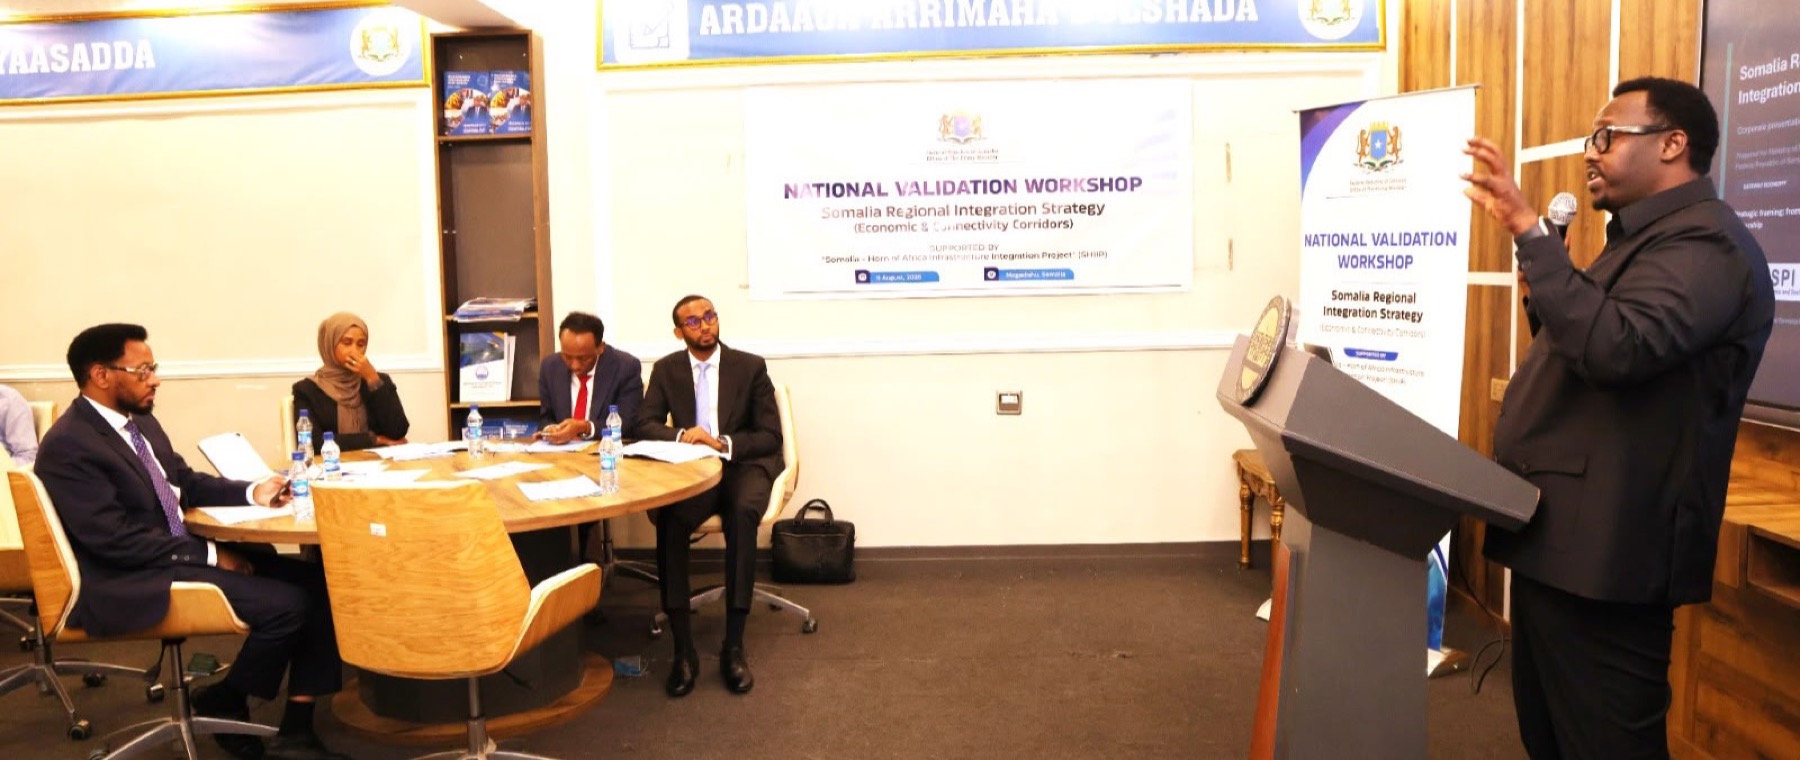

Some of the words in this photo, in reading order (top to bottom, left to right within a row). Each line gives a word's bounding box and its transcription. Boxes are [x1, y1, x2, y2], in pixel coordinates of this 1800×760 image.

[1740, 57, 1788, 80] Somalia
[1790, 53, 1800, 69] R
[1739, 80, 1800, 105] Integration
[784, 181, 888, 199] NATIONAL
[895, 179, 1017, 198] VALIDATION
[1024, 176, 1143, 194] WORKSHOP
[821, 205, 882, 219] Somalia
[886, 204, 950, 219] Regional
[954, 203, 1037, 217] Integration
[1042, 202, 1106, 216] Strategy
[854, 221, 917, 234] (Economic
[1013, 218, 1074, 230] Corridors)
[1304, 233, 1367, 247] NATIONAL
[1371, 231, 1458, 247] VALIDATION
[992, 251, 1040, 261] Integration
[1338, 254, 1414, 269] WORKSHOP
[1331, 289, 1370, 302] Somalia
[1373, 290, 1416, 305] Regional
[1323, 305, 1378, 319] Integration
[1380, 307, 1424, 323] Strategy
